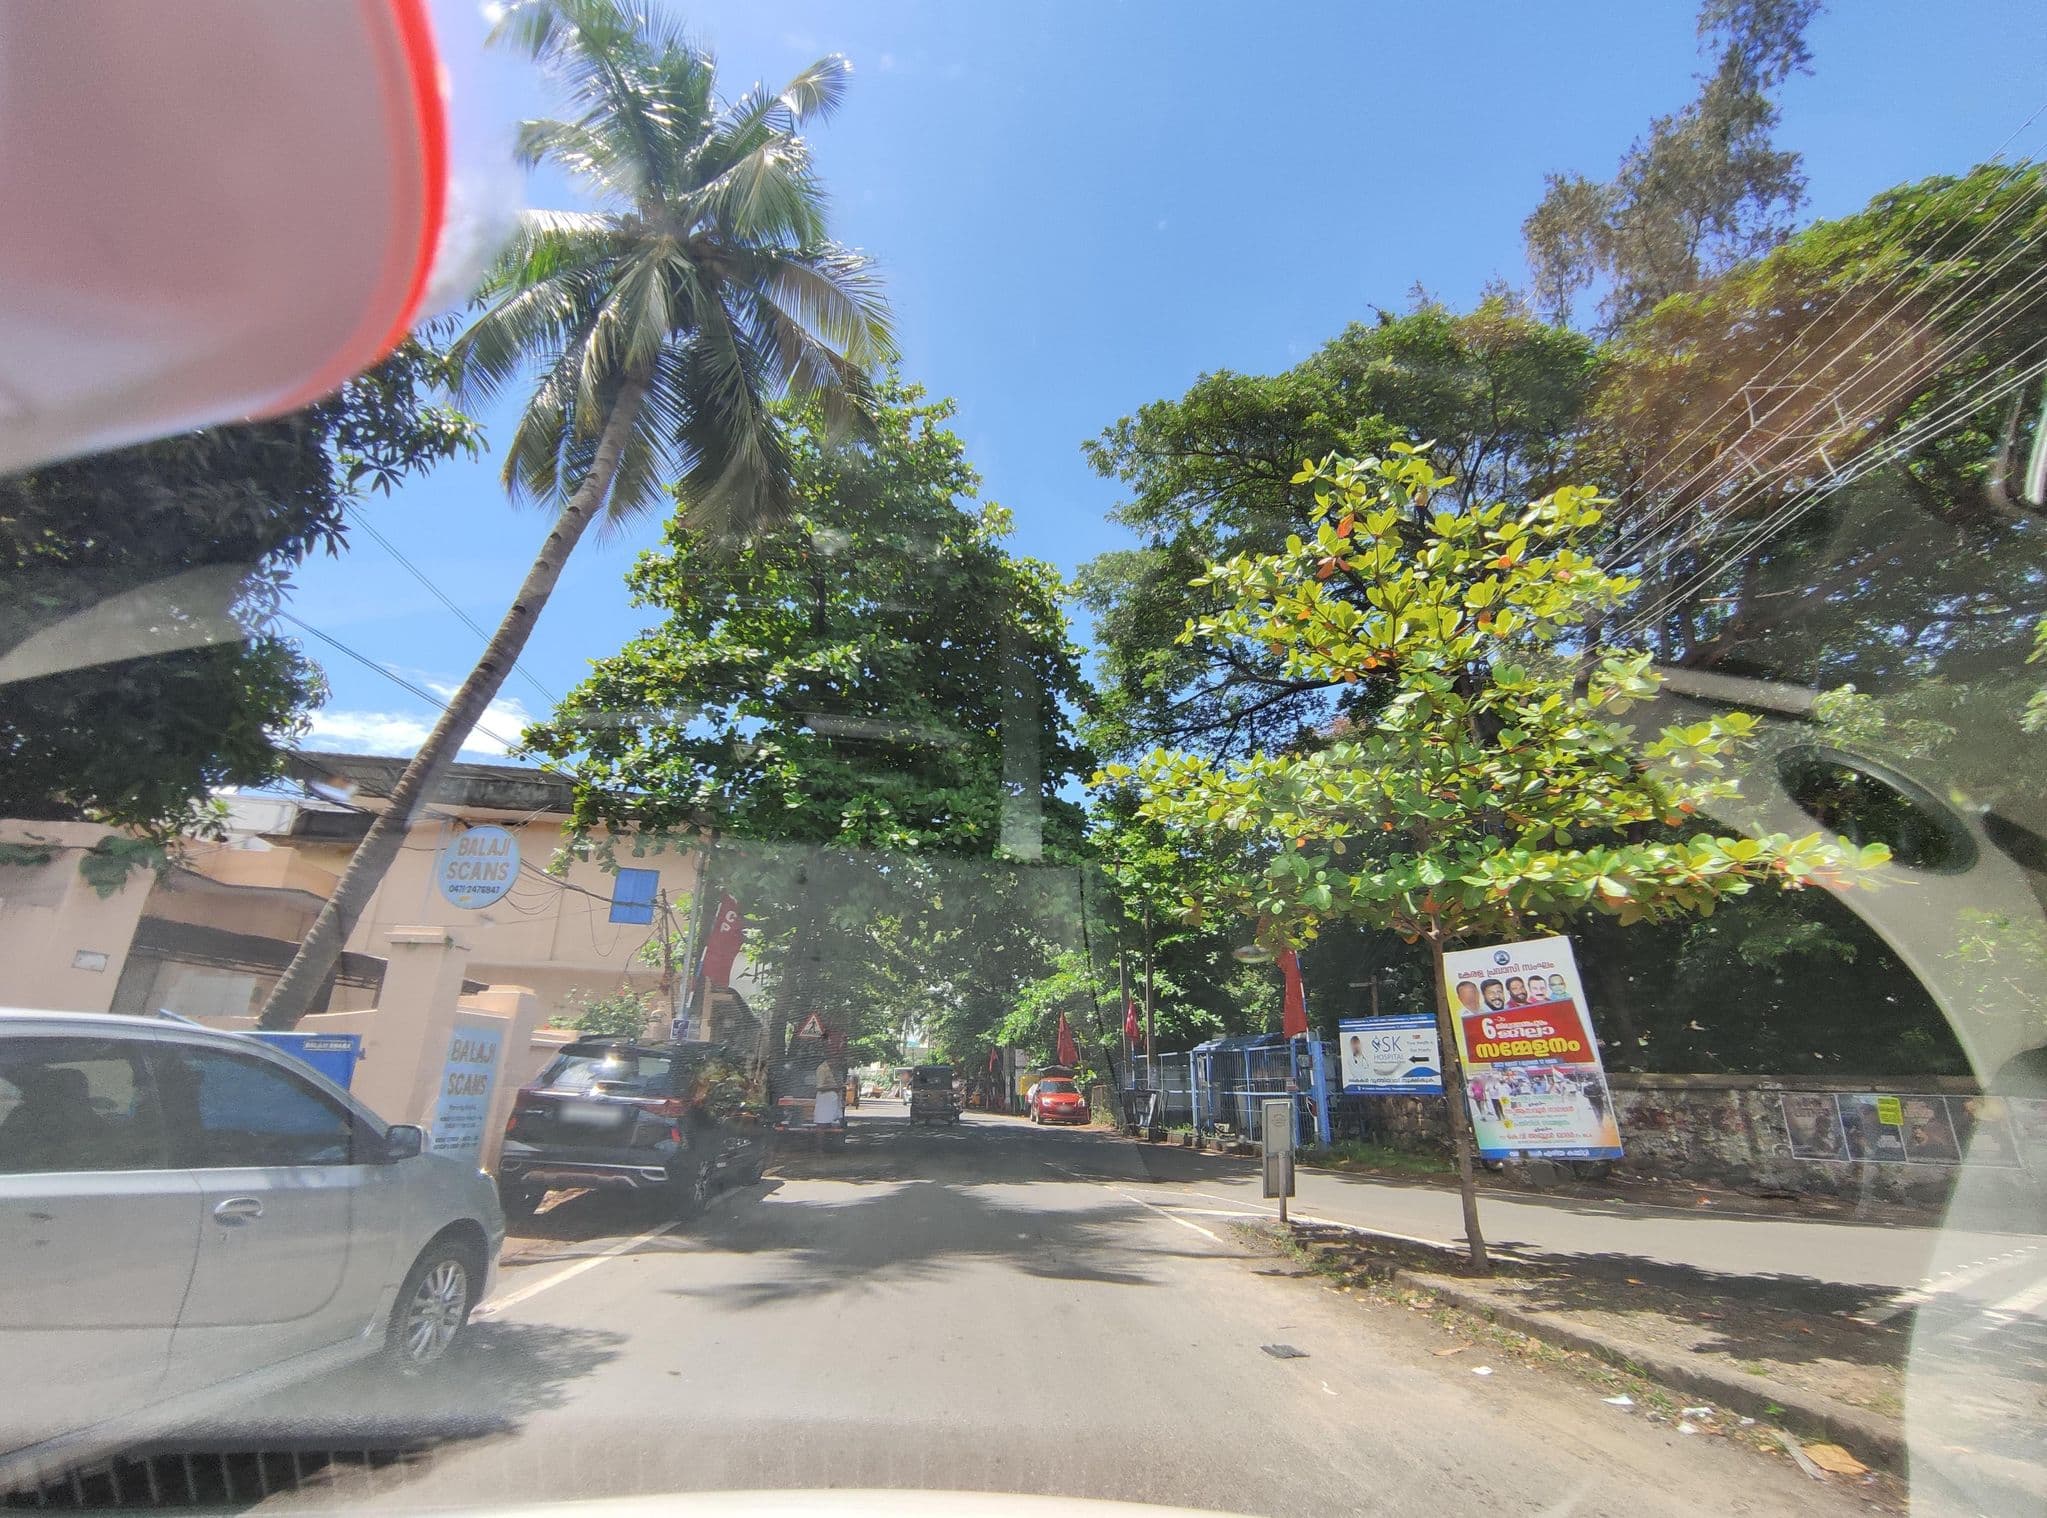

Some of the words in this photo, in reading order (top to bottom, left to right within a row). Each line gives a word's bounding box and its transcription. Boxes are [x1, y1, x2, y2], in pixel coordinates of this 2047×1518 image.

[458, 837, 512, 857] BALAJI
[446, 861, 510, 881] SCANS
[450, 1038, 497, 1064] BALAJI
[1373, 1053, 1406, 1061] HOSPITAL
[1475, 1037, 1581, 1059] സമ്മേളനം
[447, 1072, 489, 1096] SCANS
